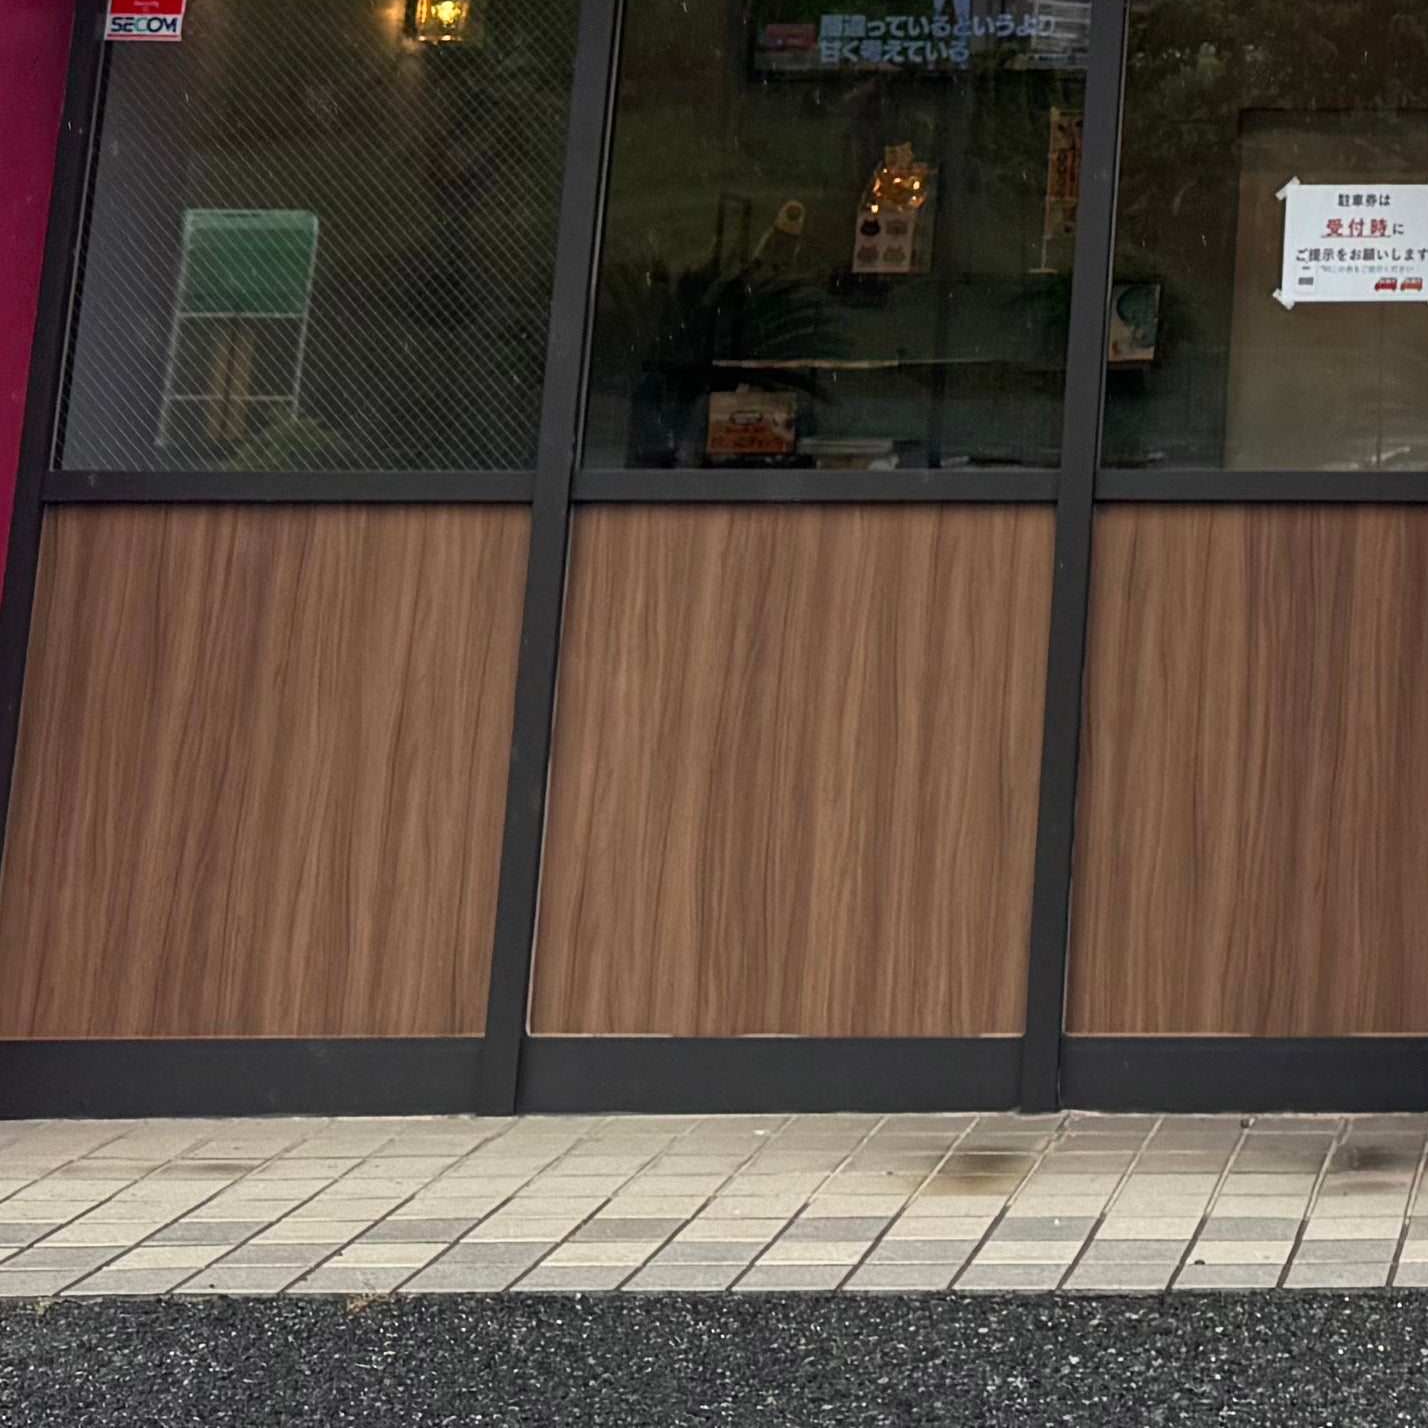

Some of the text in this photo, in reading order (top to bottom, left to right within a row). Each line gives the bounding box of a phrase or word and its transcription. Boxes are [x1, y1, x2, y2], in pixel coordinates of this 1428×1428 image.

[110, 16, 178, 34] SECOM
[1337, 193, 1391, 207] 駐車券は
[1326, 217, 1404, 237] 受付時に
